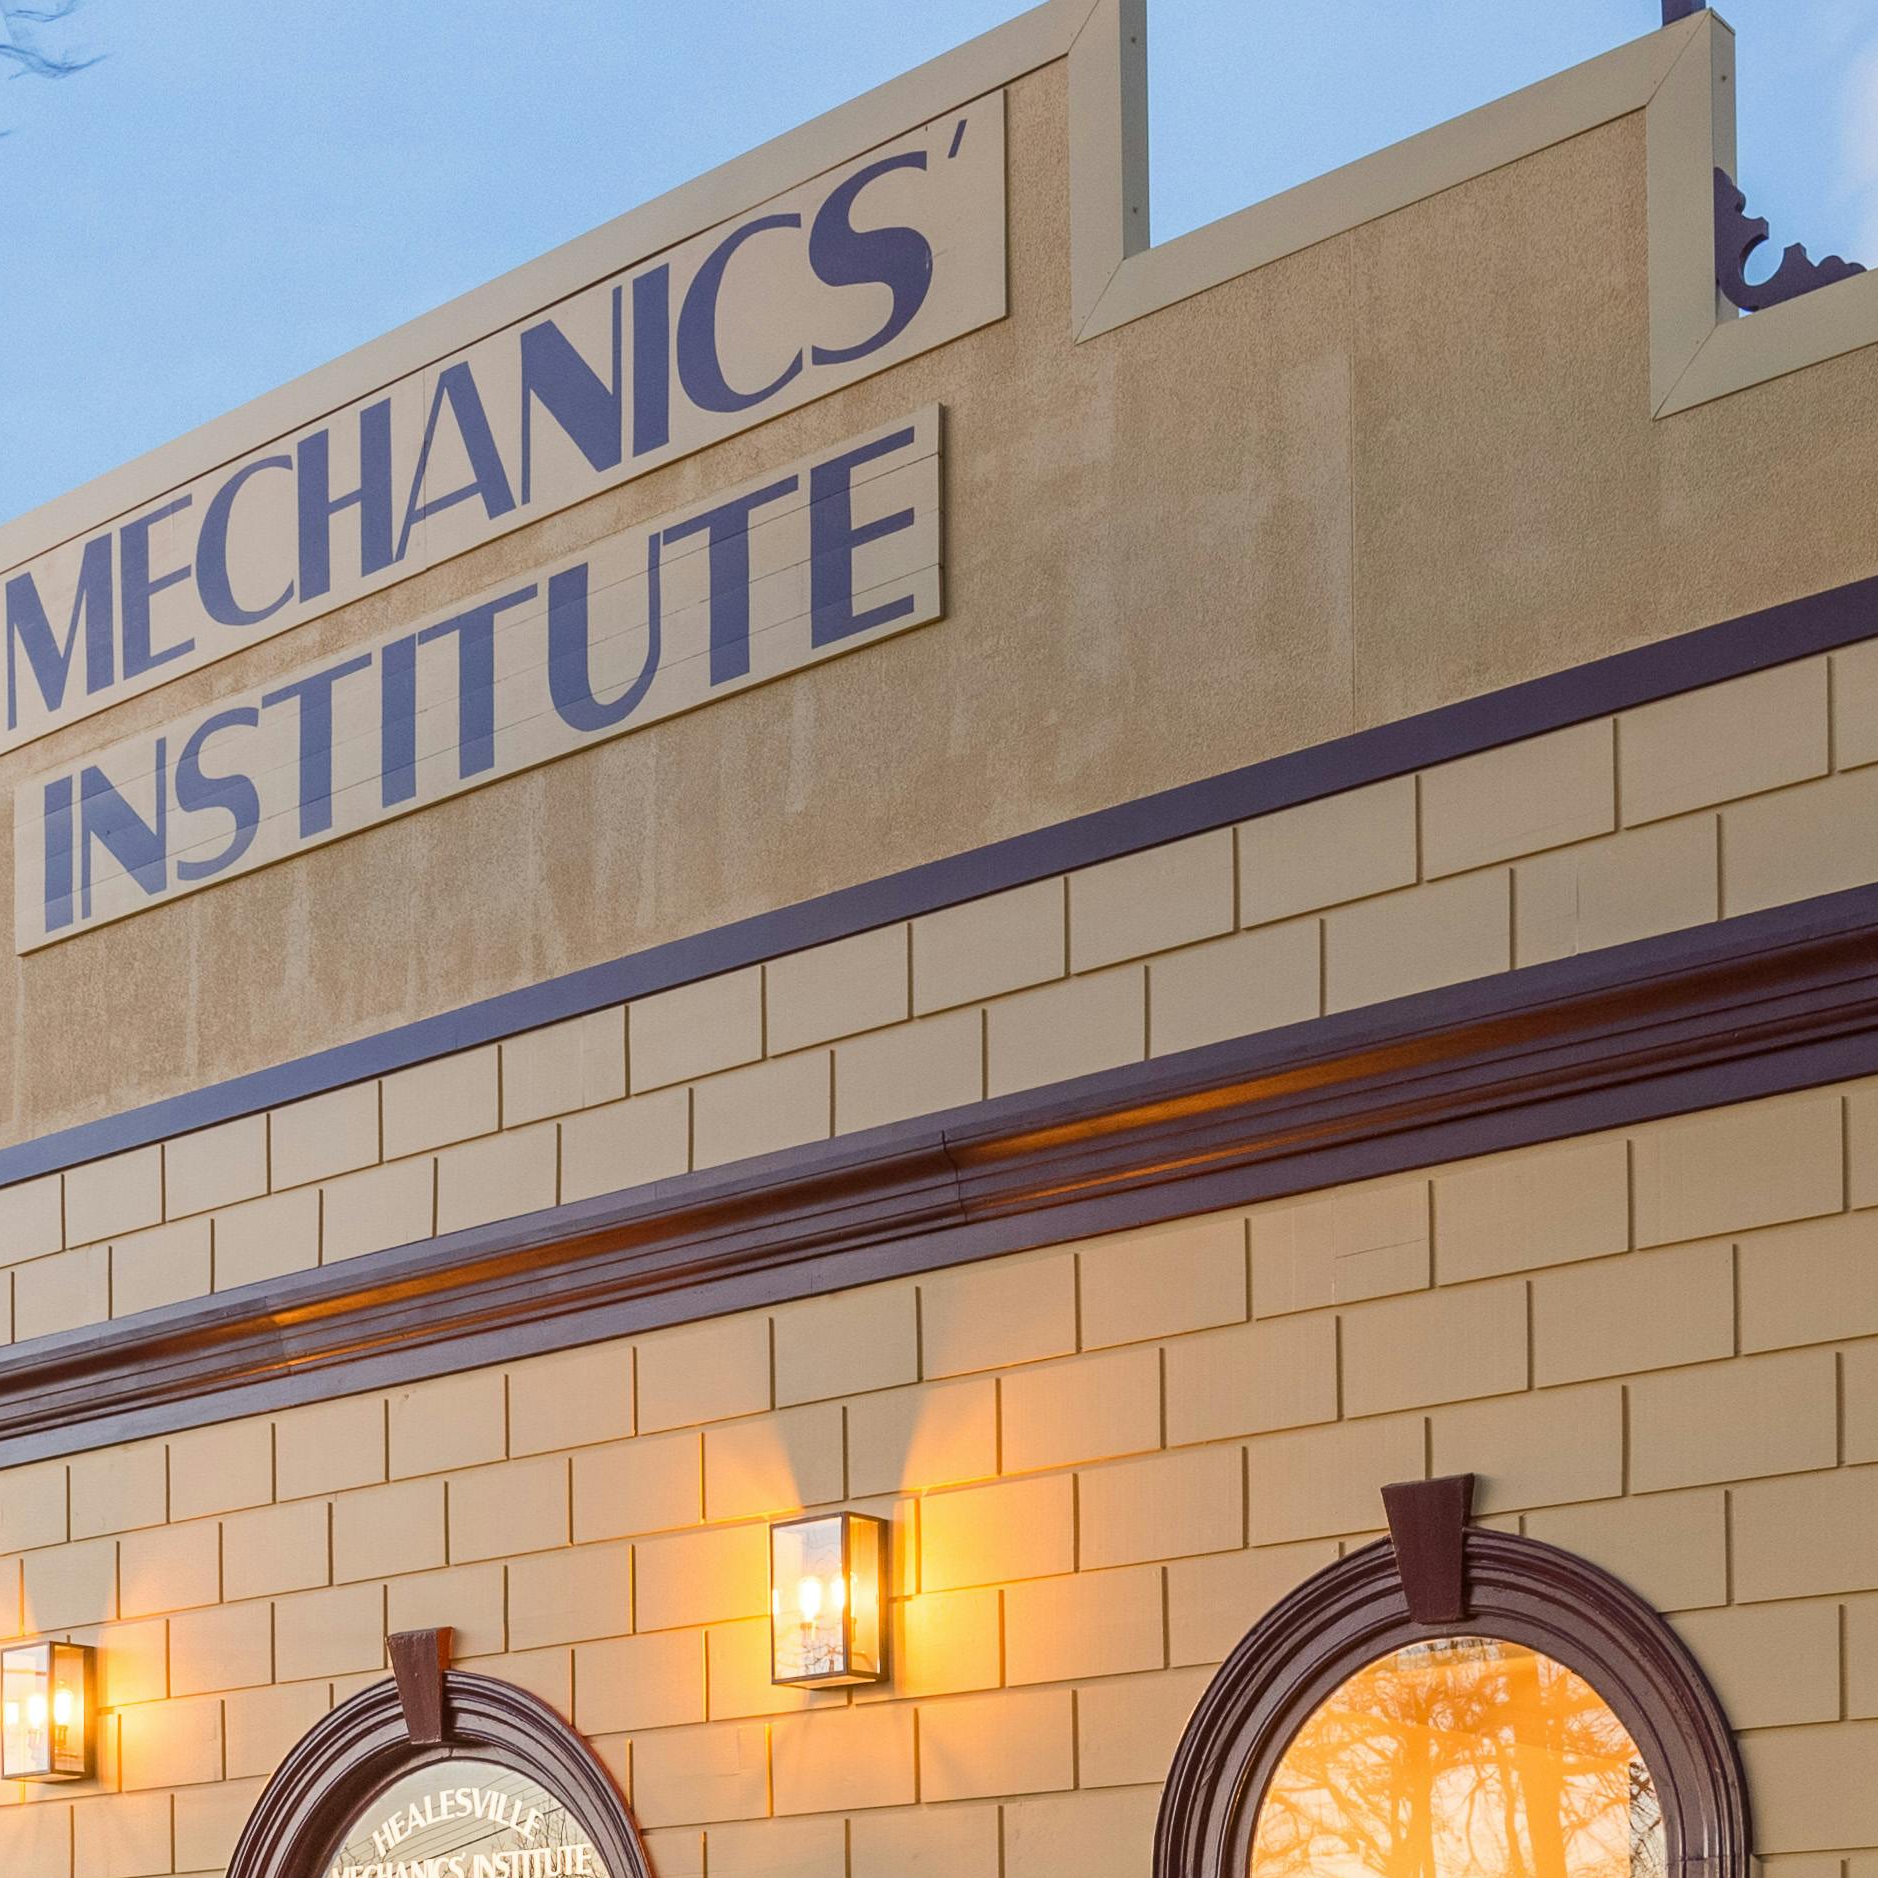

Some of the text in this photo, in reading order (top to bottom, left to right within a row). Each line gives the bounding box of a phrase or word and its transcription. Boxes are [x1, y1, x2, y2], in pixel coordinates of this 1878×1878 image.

[5, 118, 967, 732] MECHANICS'
[43, 425, 916, 934] INSTITUTE
[372, 1788, 544, 1858] HEALESVILLE
